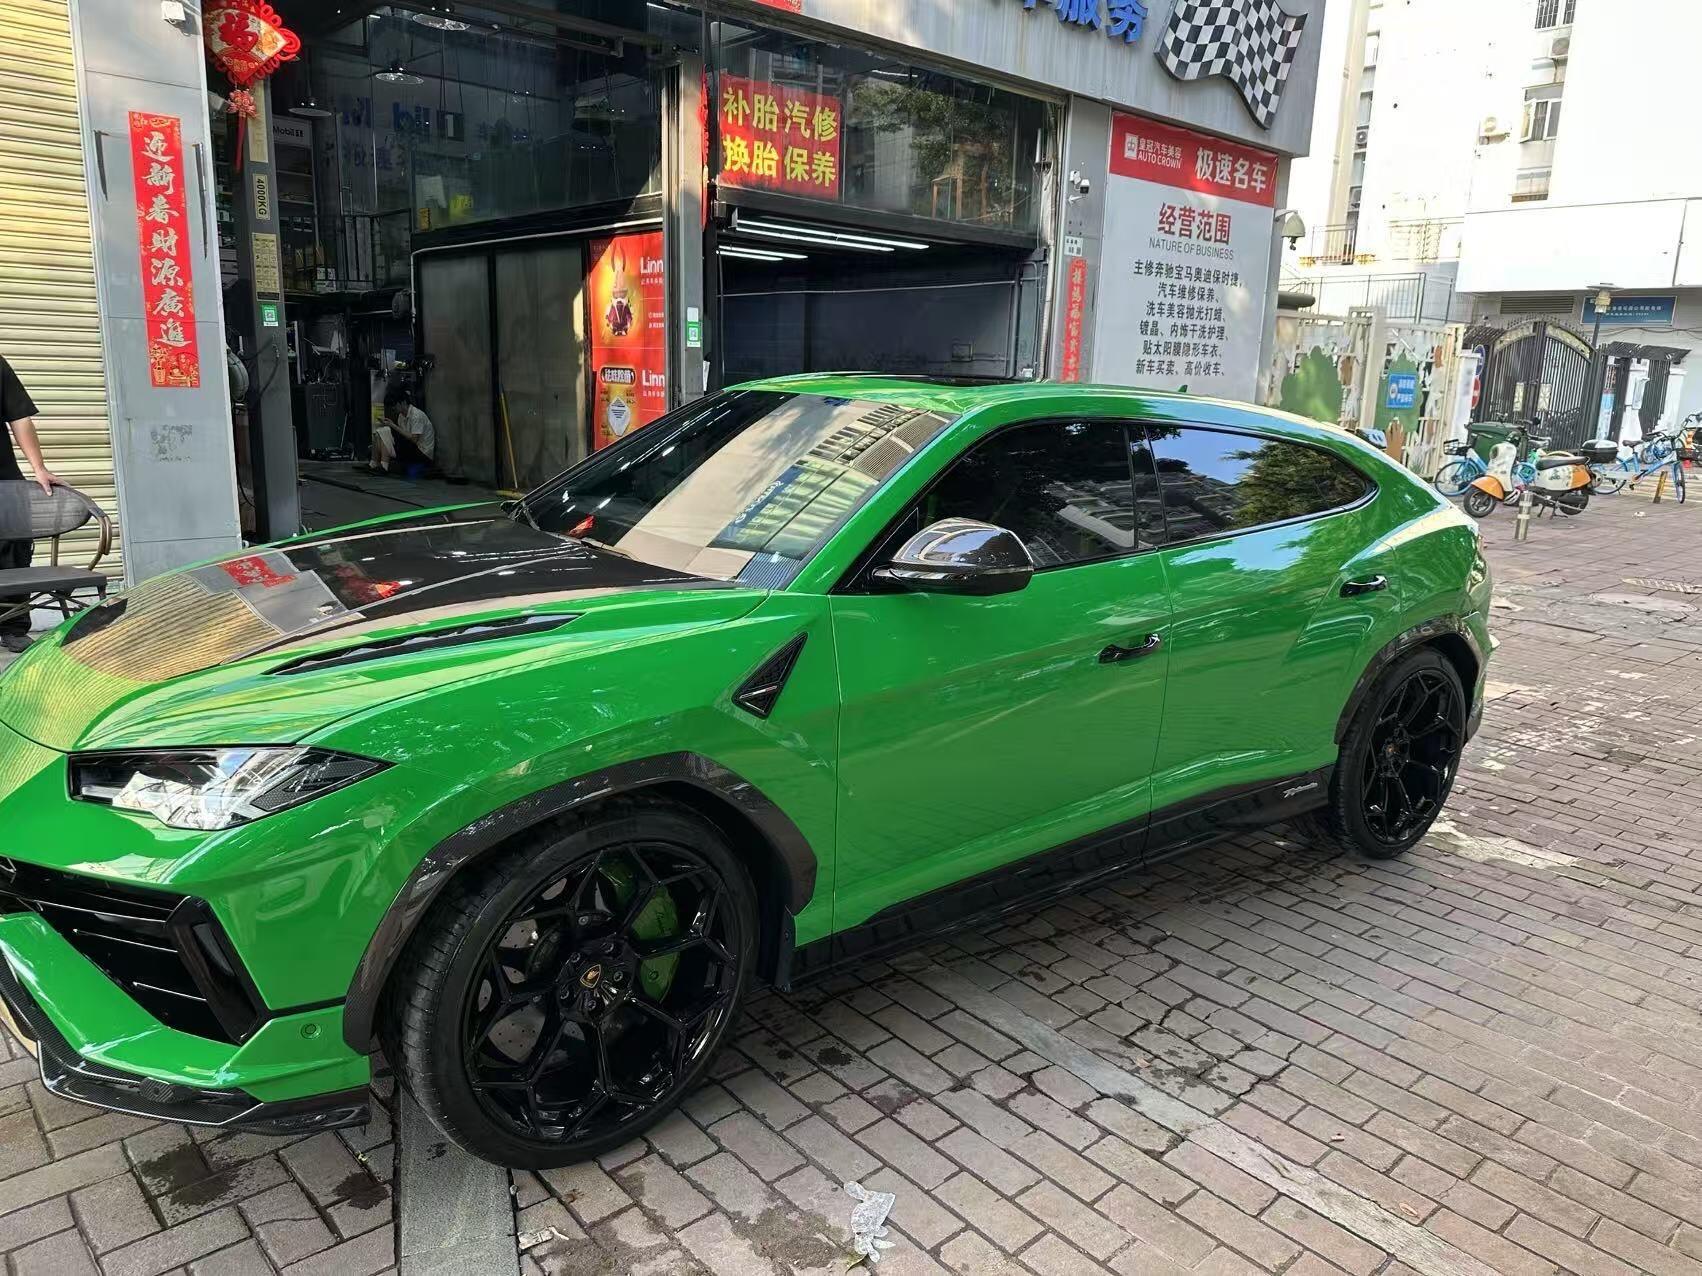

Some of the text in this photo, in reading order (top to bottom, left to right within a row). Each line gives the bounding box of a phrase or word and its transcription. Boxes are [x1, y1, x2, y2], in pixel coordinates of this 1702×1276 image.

[723, 86, 838, 142] 补胎汽修
[722, 133, 837, 187] 换胎保养
[1137, 151, 1182, 169] AUTO CROWN
[1138, 137, 1182, 160] 皇冠汽车美容
[1195, 147, 1268, 193] 极速名车
[256, 177, 267, 216] 4000KG
[1157, 202, 1232, 246] 经营范围
[1149, 238, 1234, 260] NATURE OF BUSINESS
